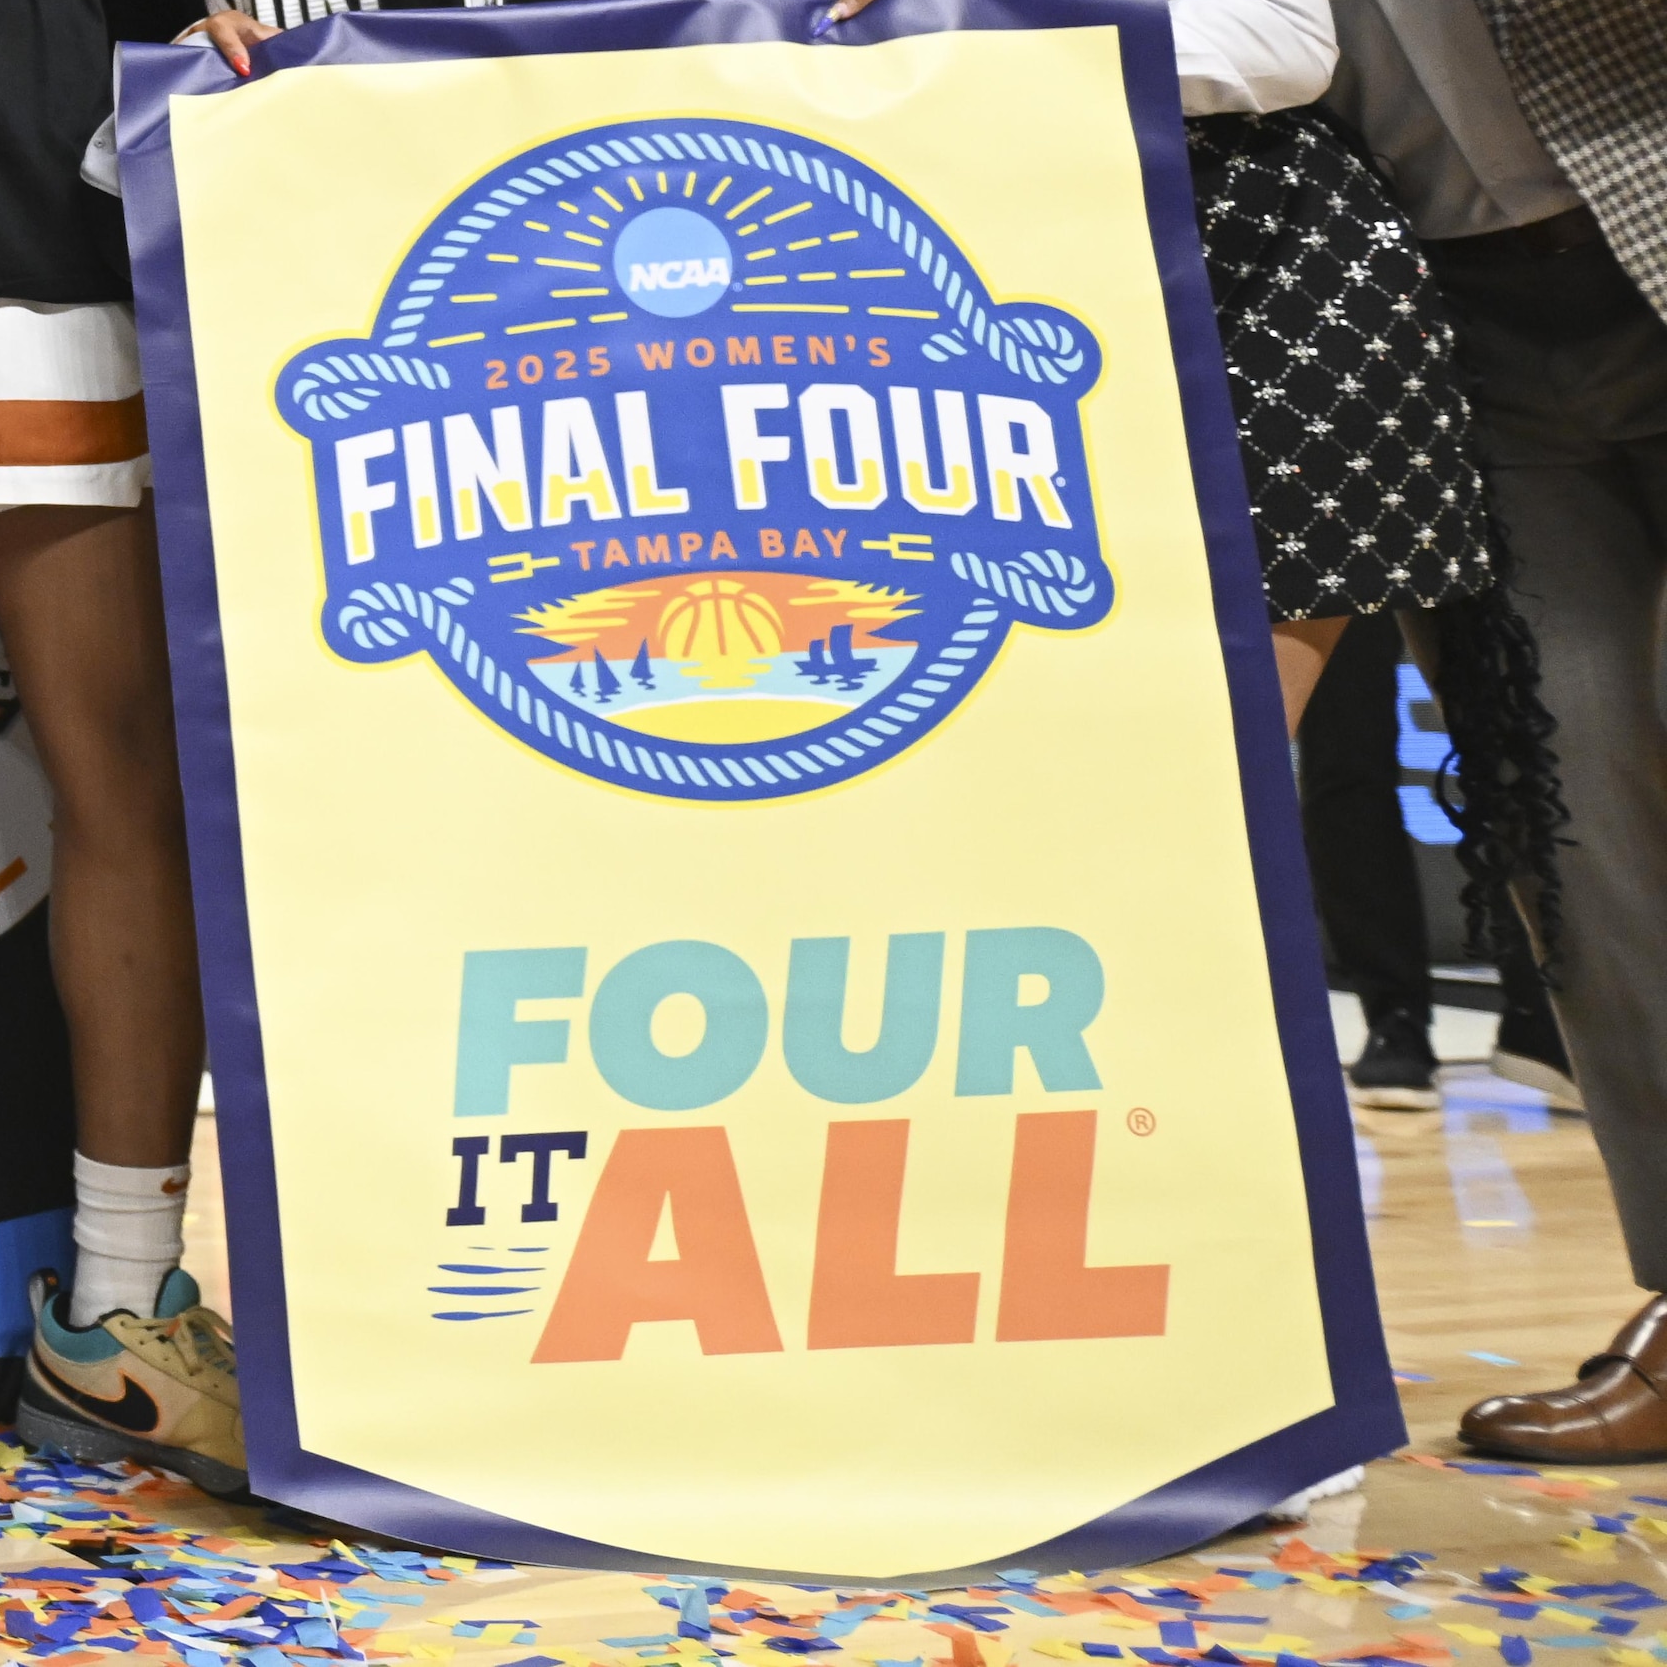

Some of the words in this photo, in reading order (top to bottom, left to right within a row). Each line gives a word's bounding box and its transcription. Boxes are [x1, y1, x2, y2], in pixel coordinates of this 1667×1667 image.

[626, 257, 731, 294] NCAA
[484, 345, 612, 391] 2025
[639, 334, 894, 372] WOMEN'S
[334, 391, 691, 567] FINAL
[721, 382, 1074, 530] FOUR
[568, 529, 738, 574] TAMPA
[760, 528, 850, 560] BAY
[453, 925, 1106, 1117] FOUR
[445, 1129, 588, 1227] IT
[529, 1109, 1170, 1365] ALL
